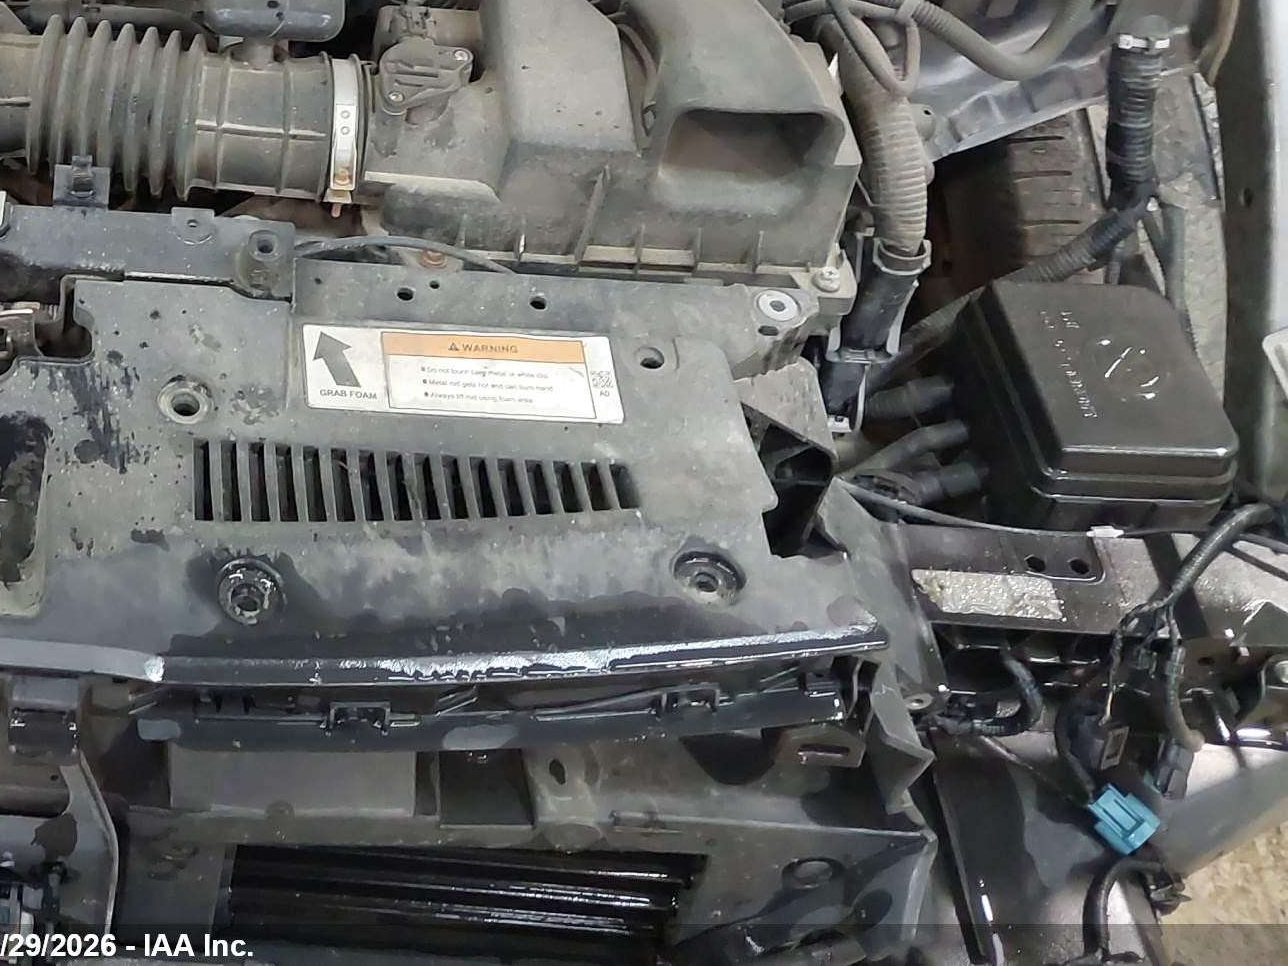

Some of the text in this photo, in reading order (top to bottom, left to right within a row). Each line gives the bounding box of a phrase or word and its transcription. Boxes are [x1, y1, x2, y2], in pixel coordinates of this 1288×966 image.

[462, 343, 519, 354] WARNING
[319, 388, 378, 400] GRAB FOAM
